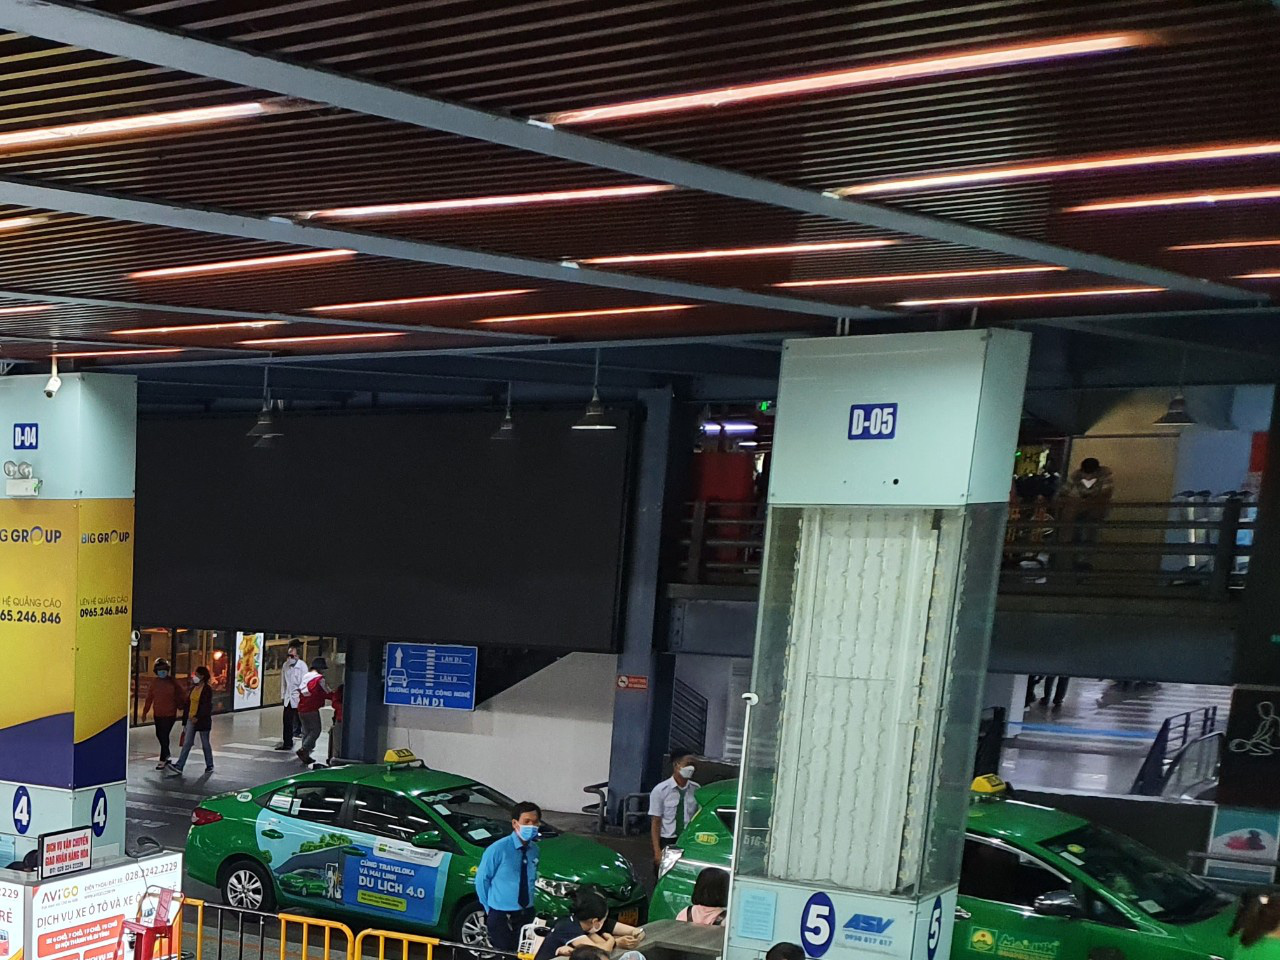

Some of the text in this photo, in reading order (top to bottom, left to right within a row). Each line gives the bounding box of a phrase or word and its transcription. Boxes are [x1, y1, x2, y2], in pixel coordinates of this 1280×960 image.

[852, 408, 893, 435] D-05
[15, 427, 36, 446] D-04
[11, 526, 61, 545] GROUP
[81, 530, 129, 544] BIG GROUP
[1, 596, 11, 607] HỆ
[80, 607, 128, 618] 0965.246.846
[411, 695, 444, 707] LÀN D1
[15, 796, 29, 825] 4
[93, 798, 106, 827] 4
[379, 863, 415, 876] TRAVELOKA
[382, 872, 396, 880] LINH
[359, 876, 425, 898] DU LỊCH 4.0
[0, 906, 13, 923] RẺ
[37, 895, 133, 930] DỊCH VỤ XE Ô TÔ VÀ XE
[804, 903, 830, 946] 5
[843, 914, 895, 933] ASV
[928, 908, 942, 950] 5
